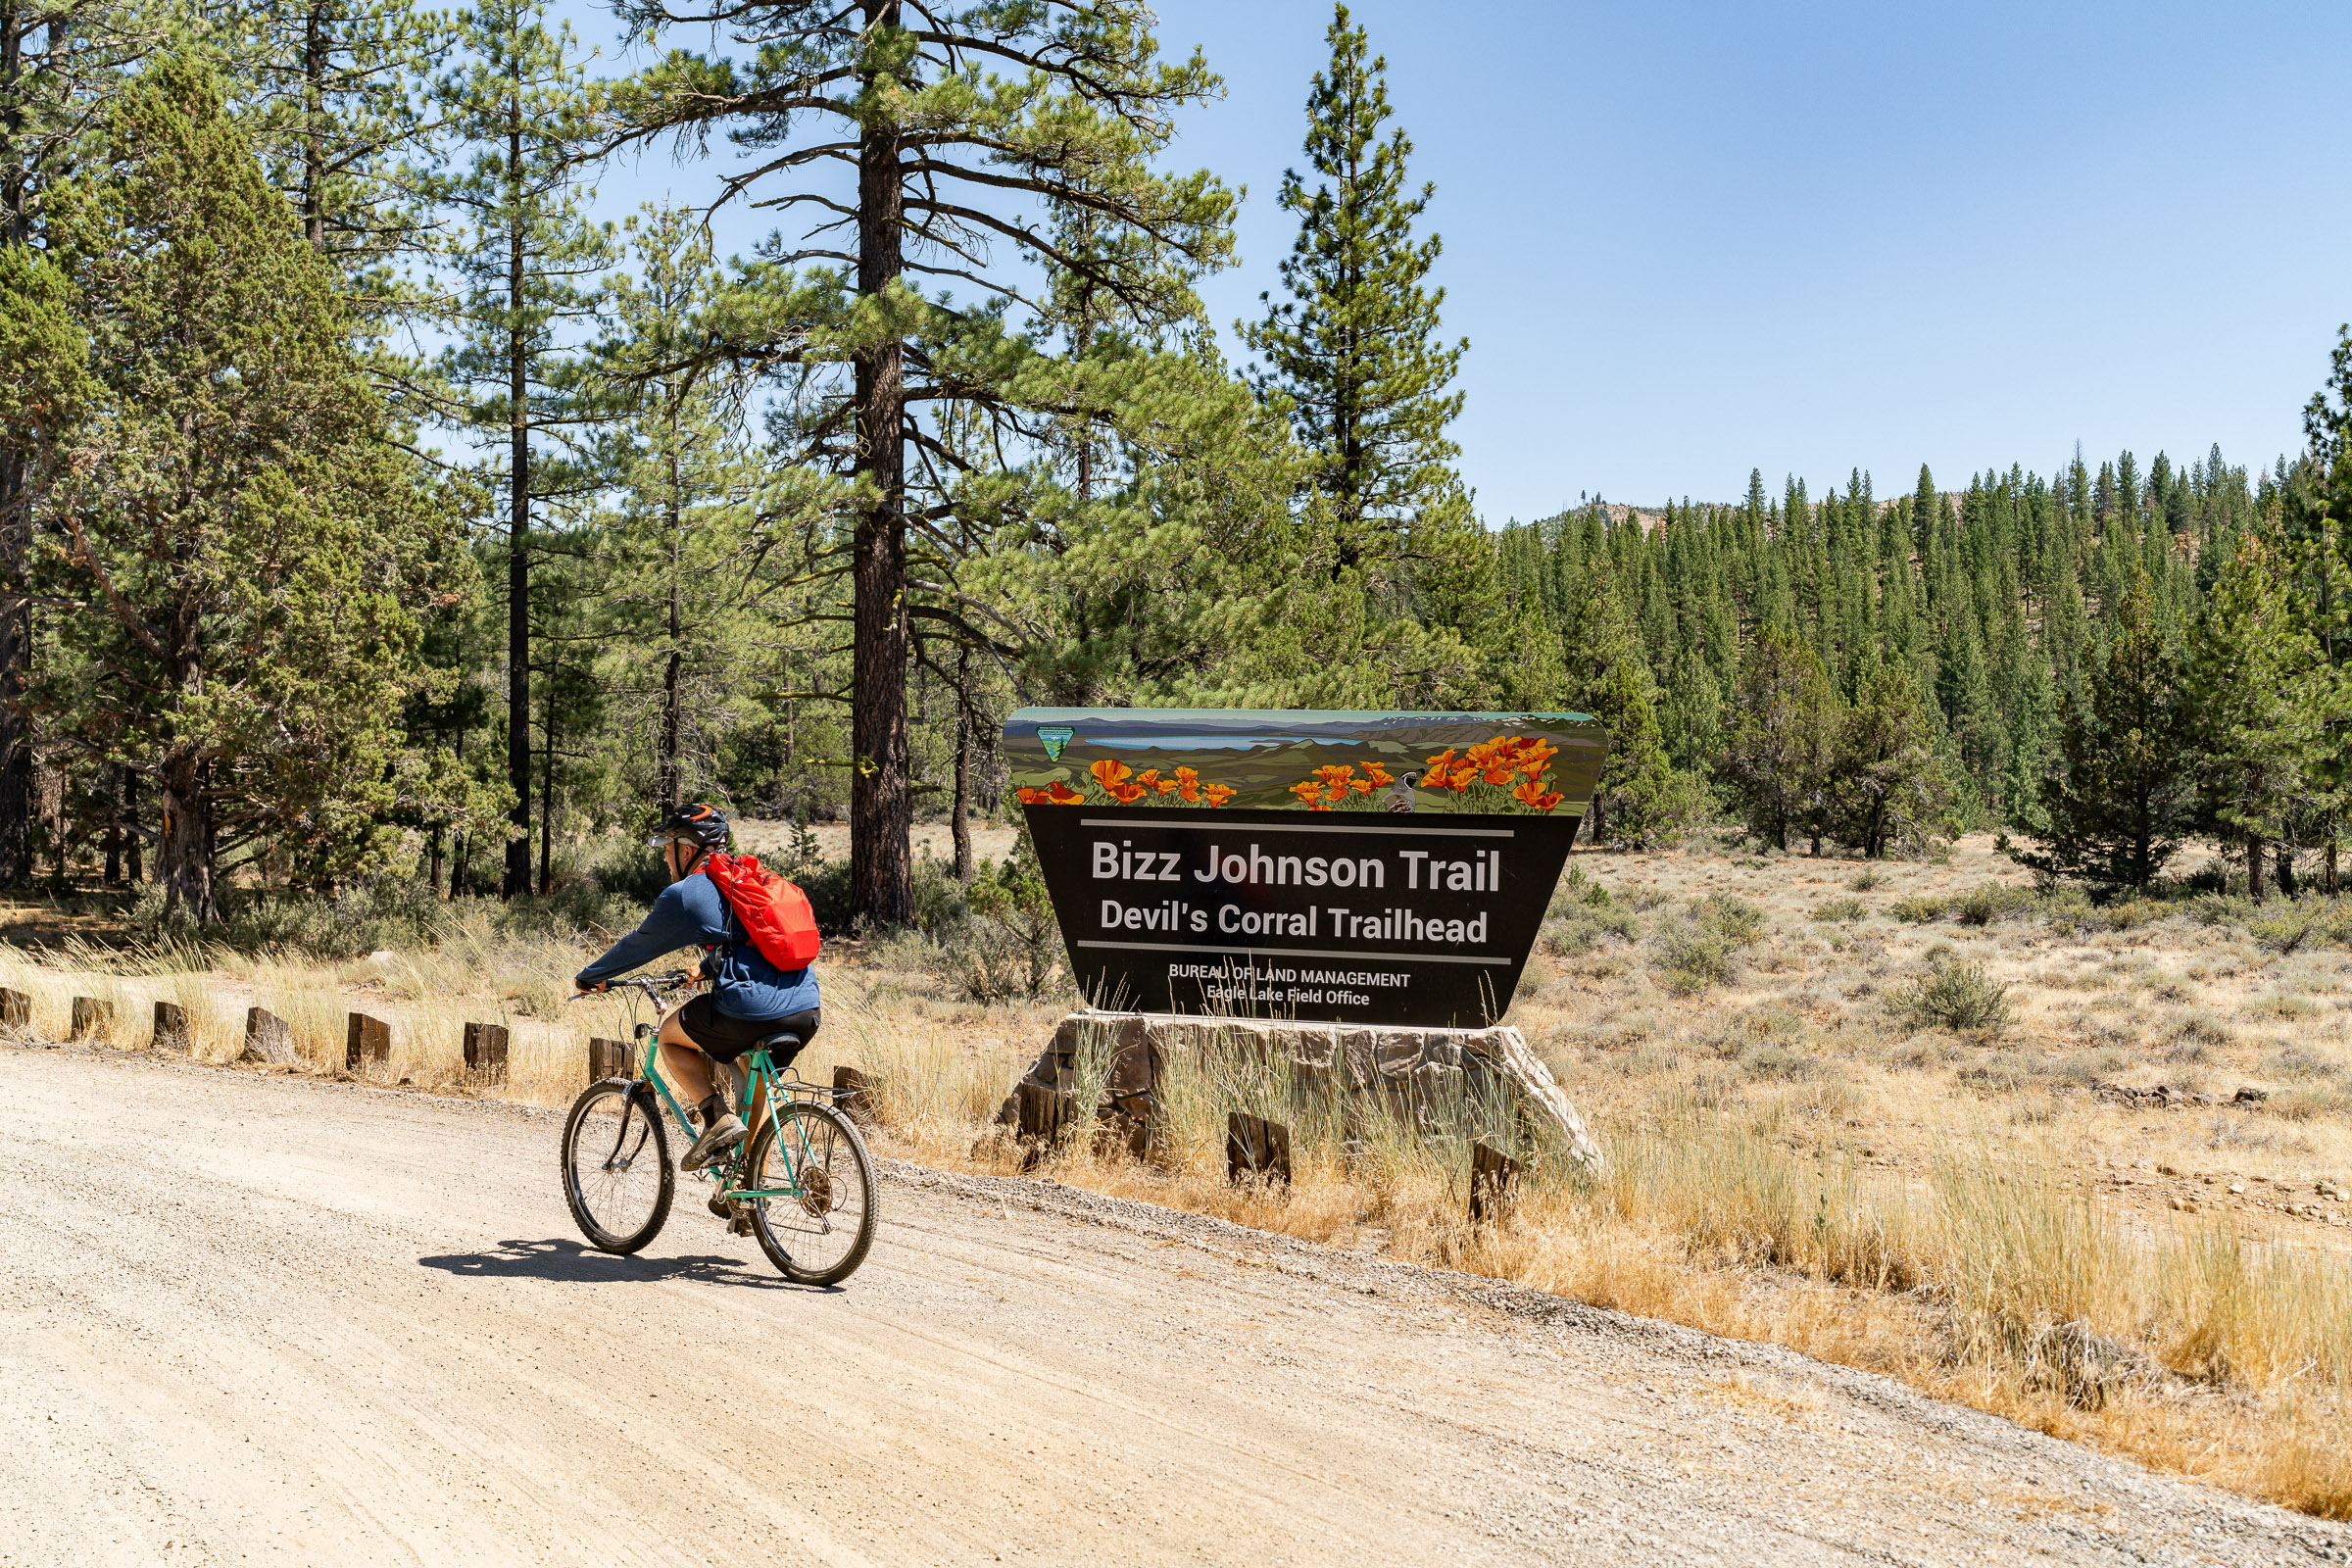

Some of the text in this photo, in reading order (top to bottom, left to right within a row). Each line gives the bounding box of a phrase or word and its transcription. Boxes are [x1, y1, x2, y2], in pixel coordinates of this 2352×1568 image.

[1092, 840, 1499, 892] Bizz Johnson Trail
[1101, 899, 1488, 944] Devil's Corral Trailhead
[1169, 963, 1411, 988] BUREAU OF LAND MANAGEMENT
[1206, 985, 1370, 1005] Eagle Lake Field Office
